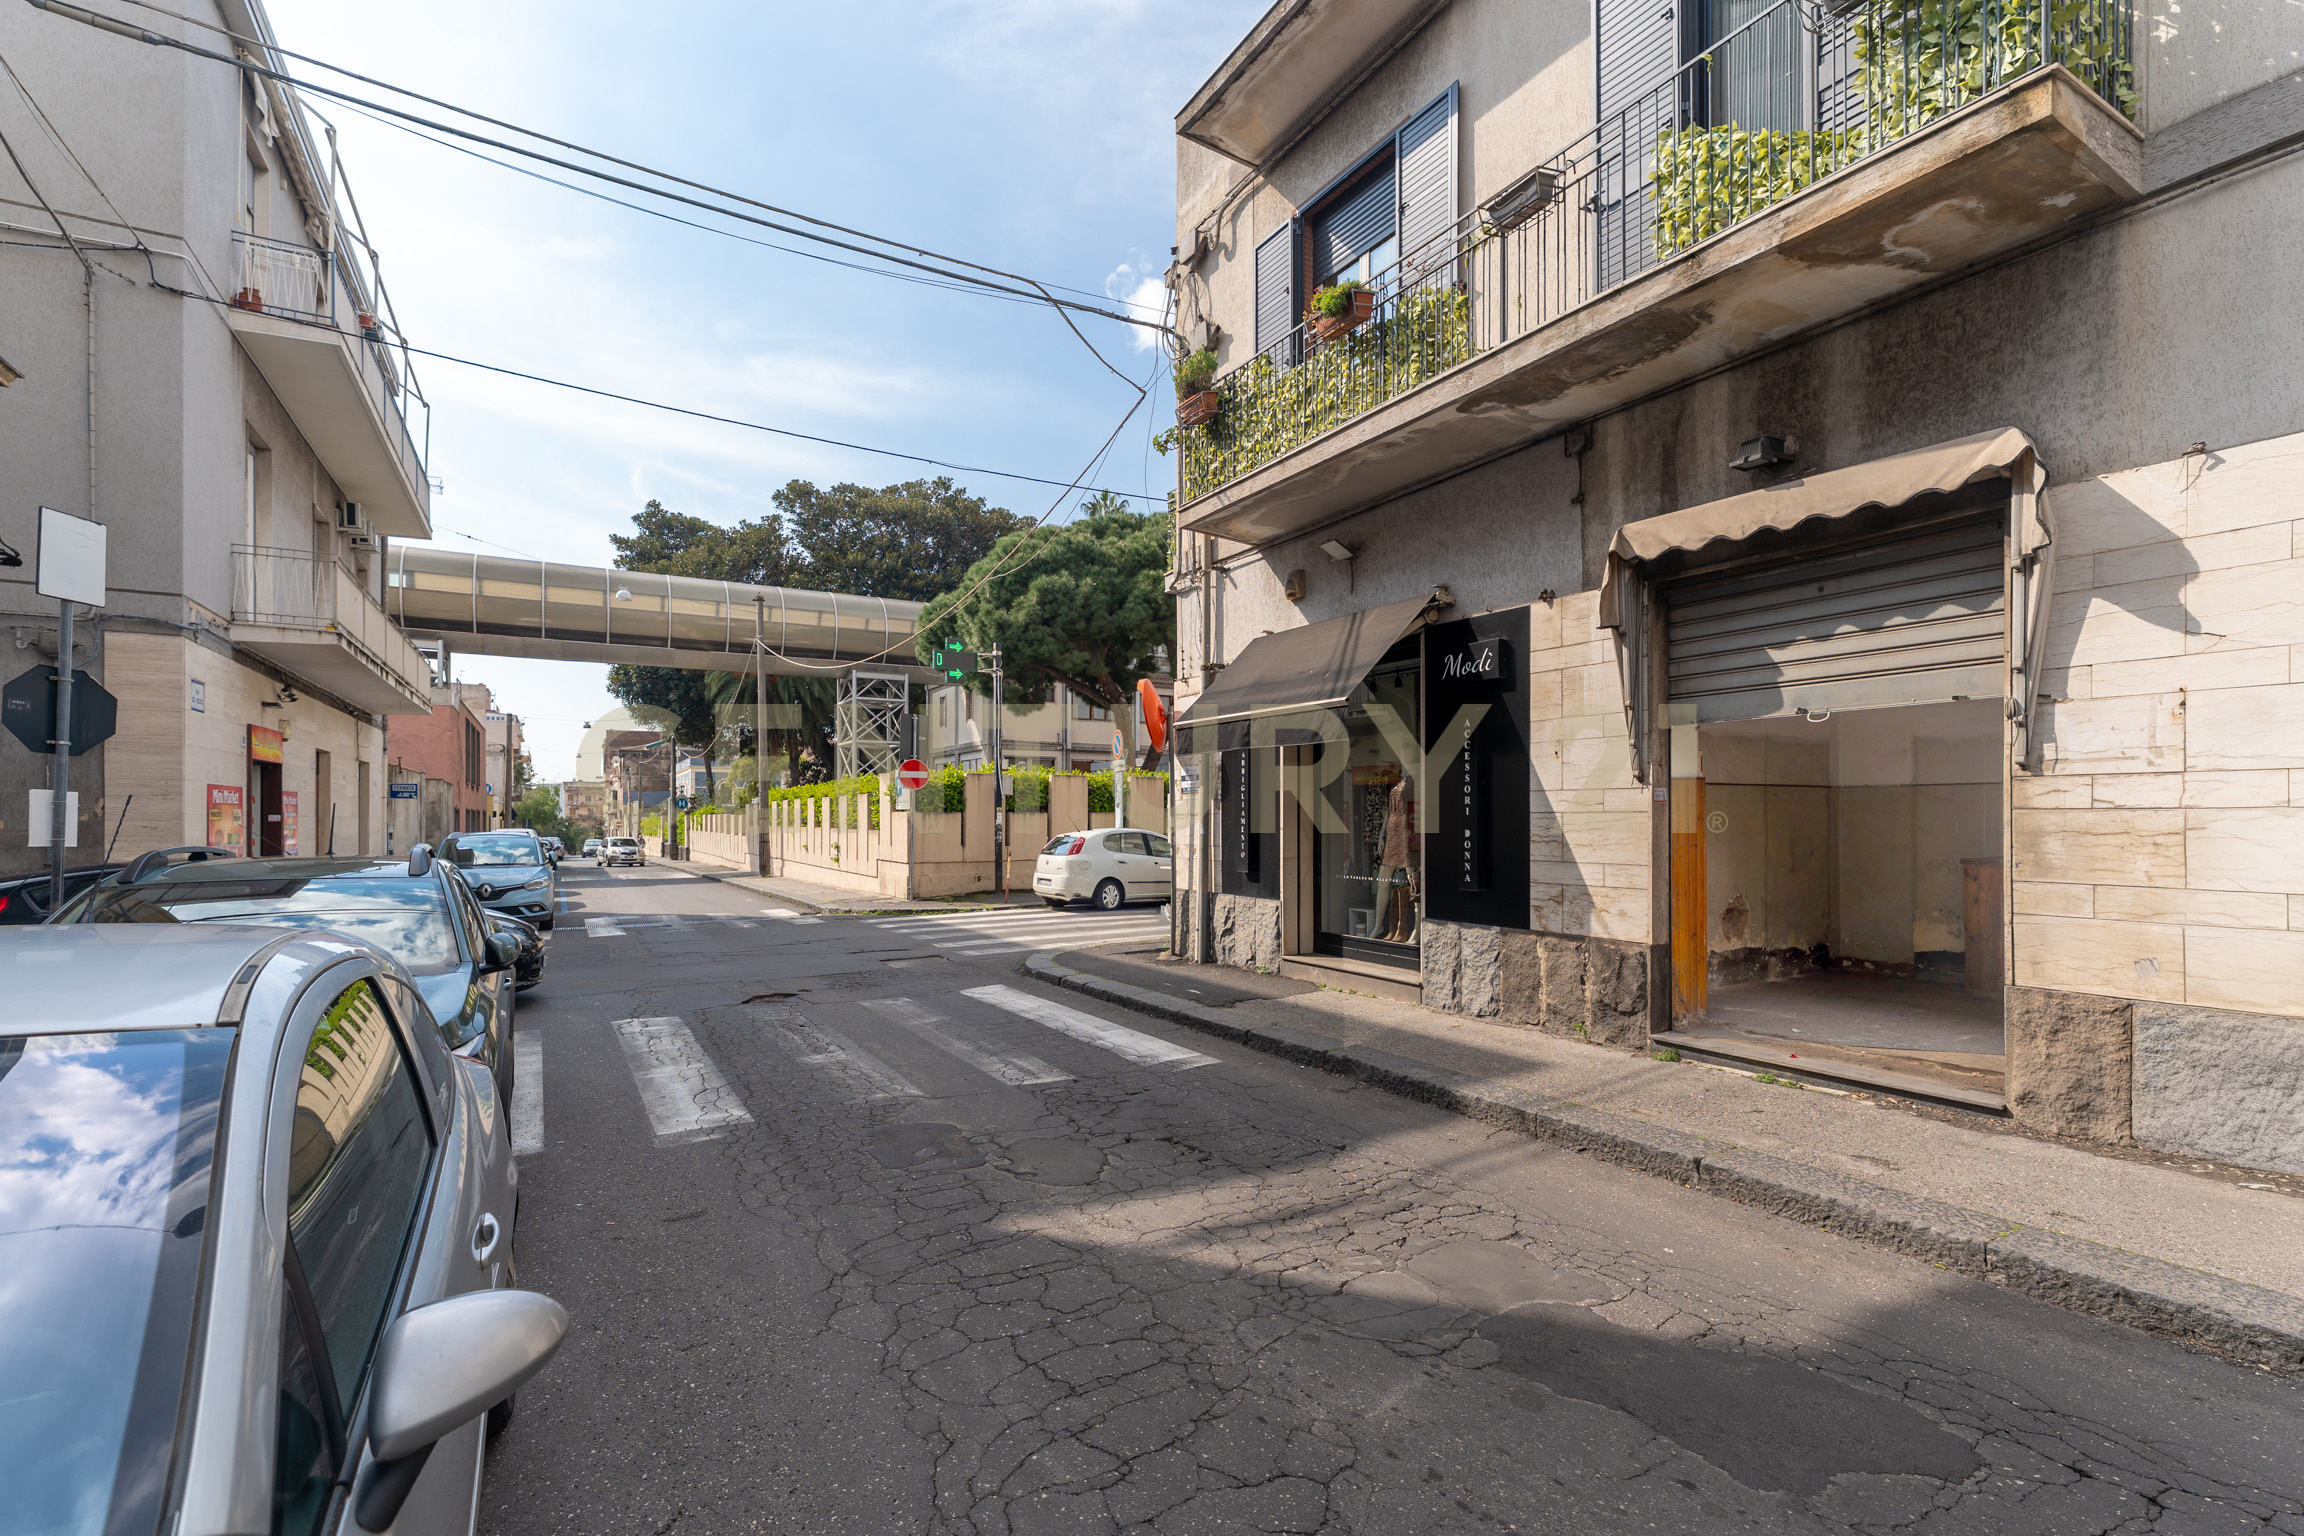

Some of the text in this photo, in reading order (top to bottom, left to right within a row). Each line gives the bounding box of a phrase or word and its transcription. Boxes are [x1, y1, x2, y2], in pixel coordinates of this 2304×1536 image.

[1442, 647, 1494, 680] Modì
[213, 789, 239, 804] Mini Market
[679, 800, 686, 808] H
